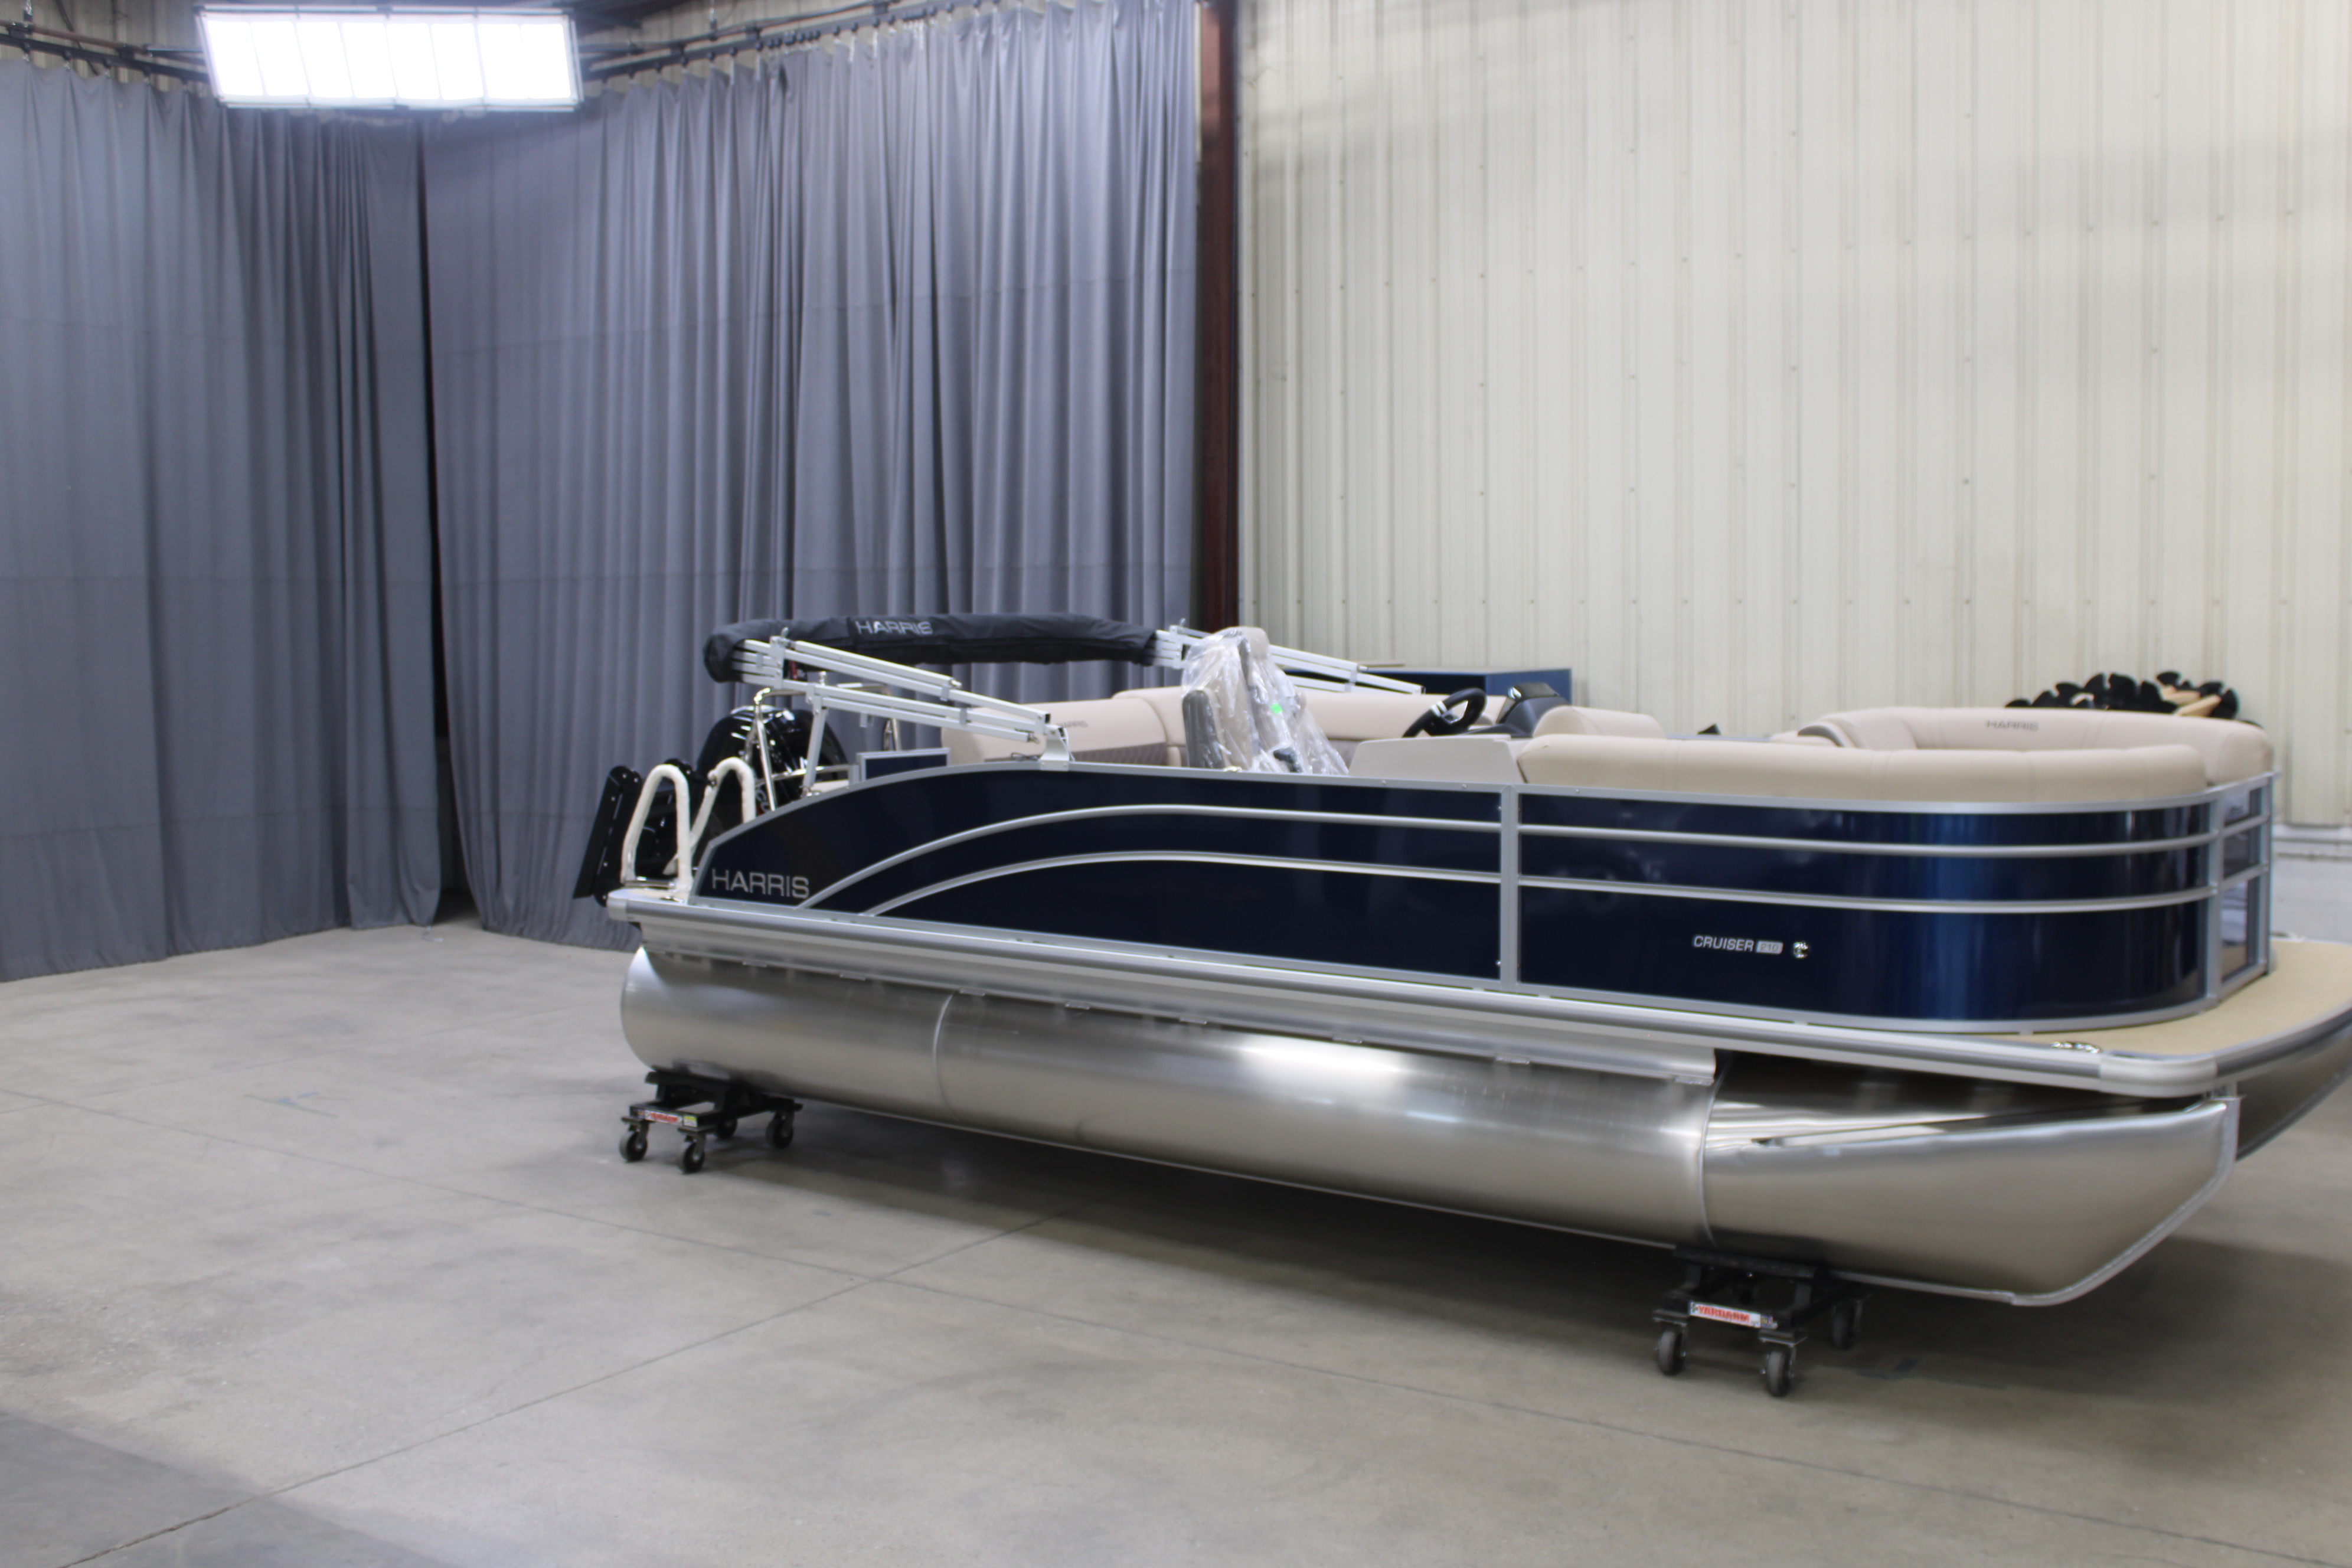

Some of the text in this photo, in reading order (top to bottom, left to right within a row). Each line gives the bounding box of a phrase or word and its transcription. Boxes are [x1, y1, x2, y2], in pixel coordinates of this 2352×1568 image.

[855, 620, 933, 635] HARRIS
[1986, 720, 2039, 731] HARRIS
[712, 869, 809, 899] HARRIS
[1693, 935, 1754, 952] CRUISER
